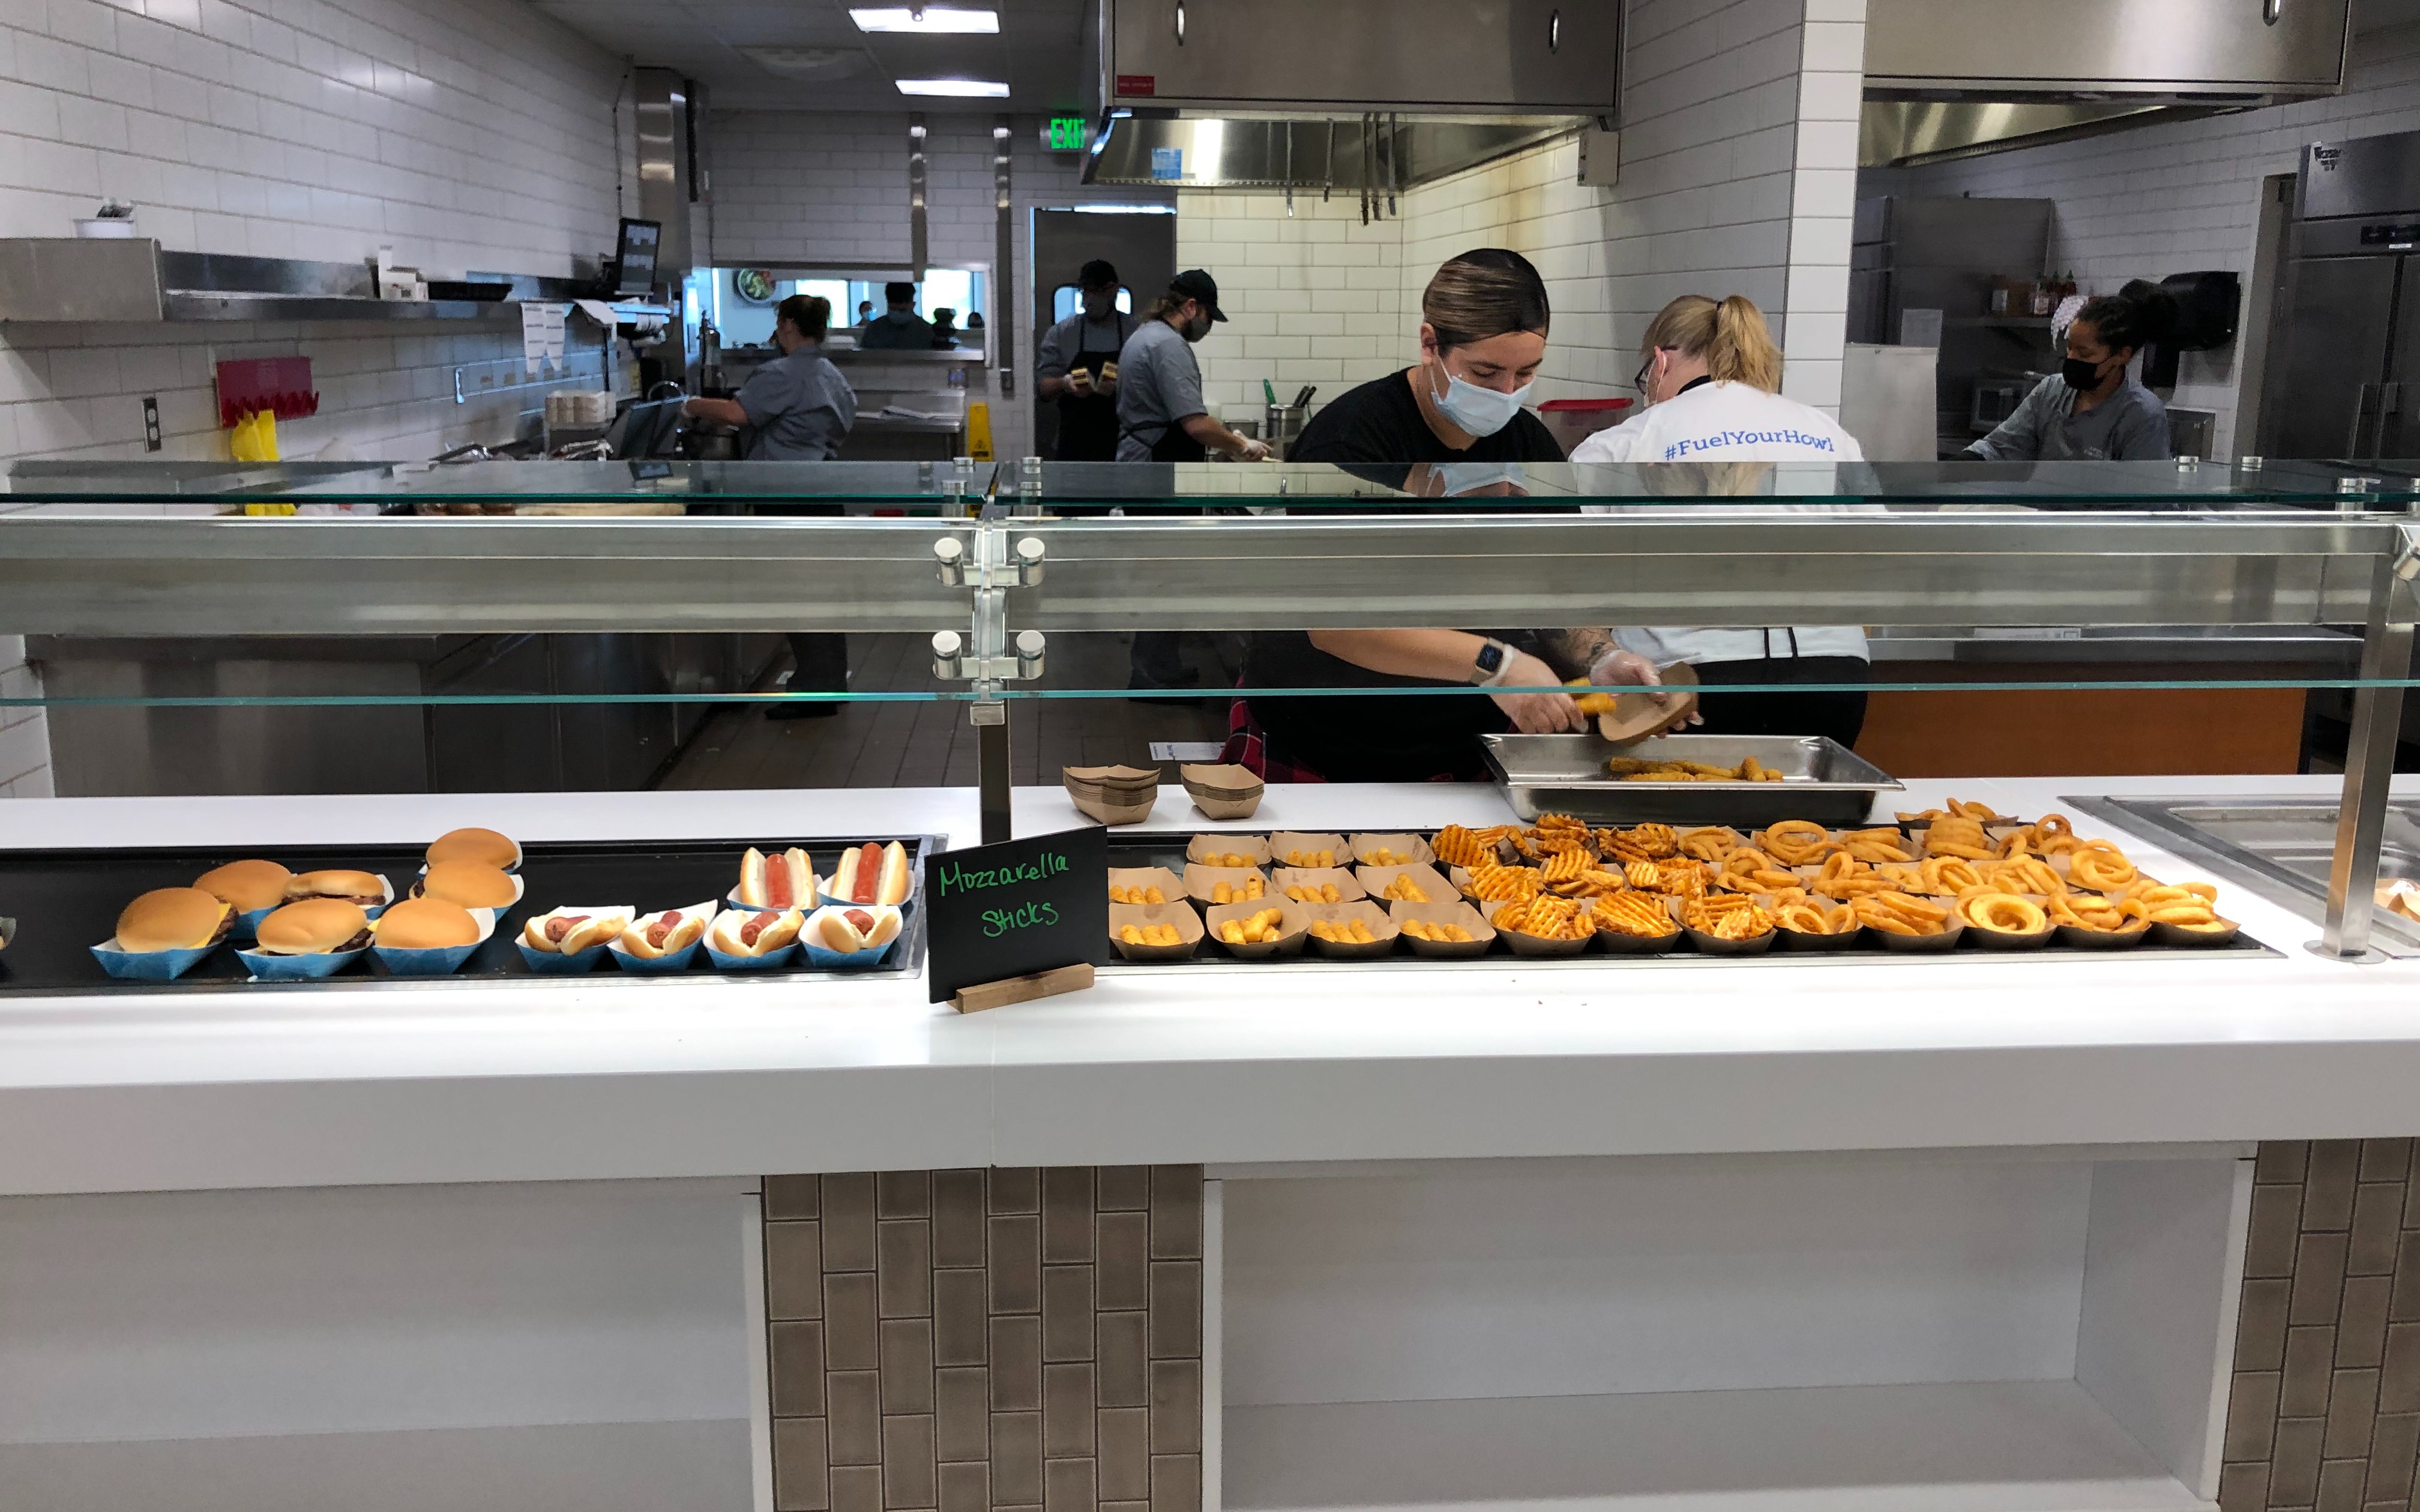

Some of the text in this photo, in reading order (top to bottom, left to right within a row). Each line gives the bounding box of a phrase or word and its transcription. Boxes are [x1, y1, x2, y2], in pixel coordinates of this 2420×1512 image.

[1050, 118, 1085, 149] EXIT
[1664, 430, 1835, 460] #FuelYourHowl
[940, 852, 1070, 896] Mozzarella
[981, 901, 1059, 937] Sticks
